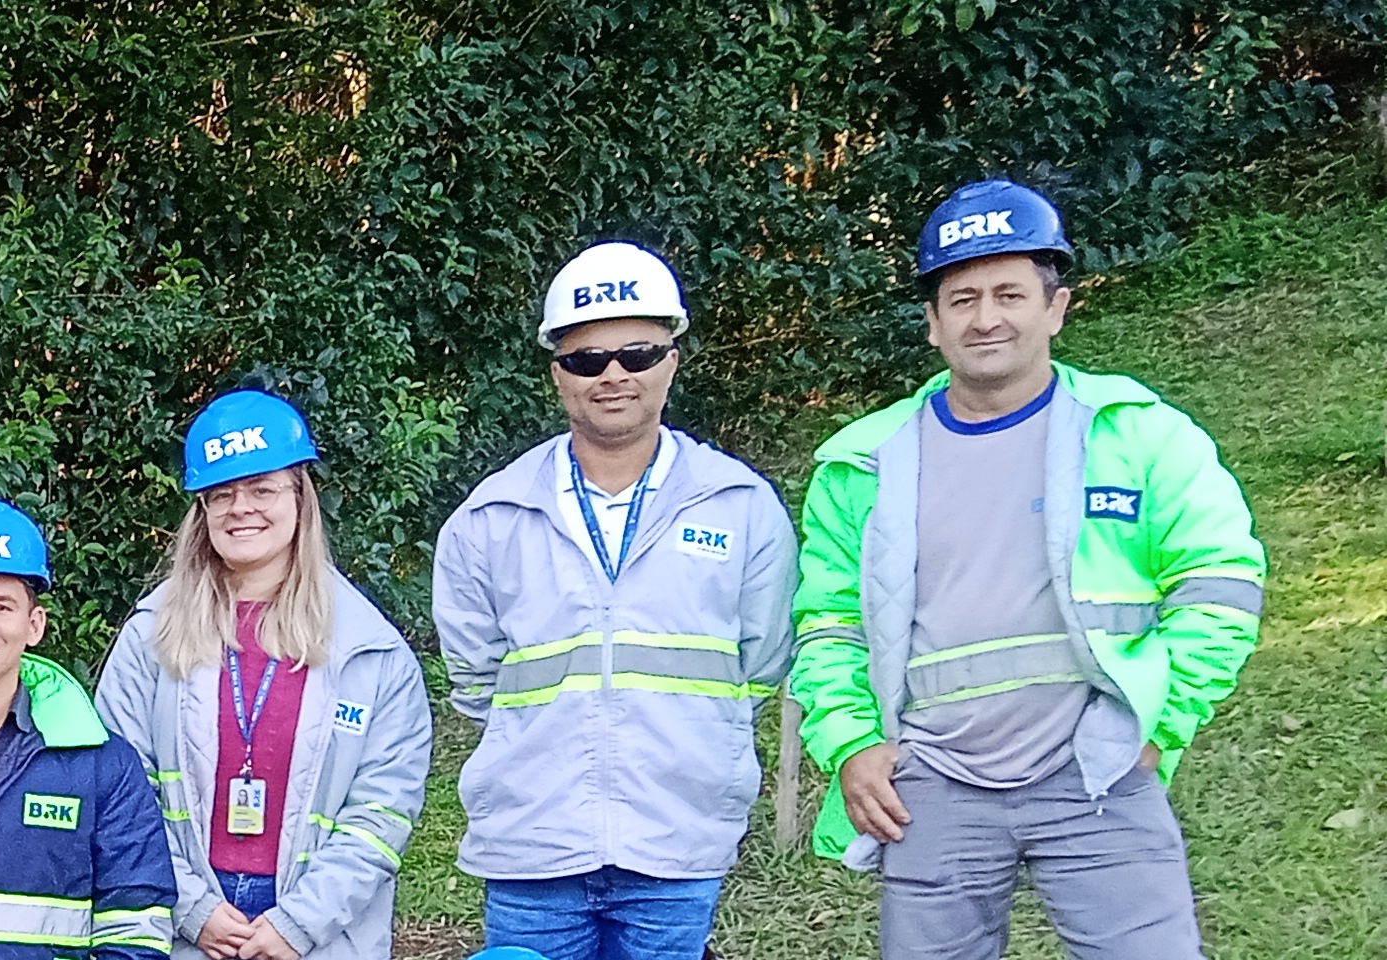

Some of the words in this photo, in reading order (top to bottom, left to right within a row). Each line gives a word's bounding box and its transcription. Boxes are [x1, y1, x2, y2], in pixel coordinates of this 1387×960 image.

[938, 209, 1014, 248] BRK
[573, 280, 640, 309] BRK
[204, 426, 269, 463] BRK
[1089, 492, 1137, 515] BRK
[683, 528, 728, 549] BRK
[335, 703, 364, 725] RK
[29, 802, 73, 822] BRK
